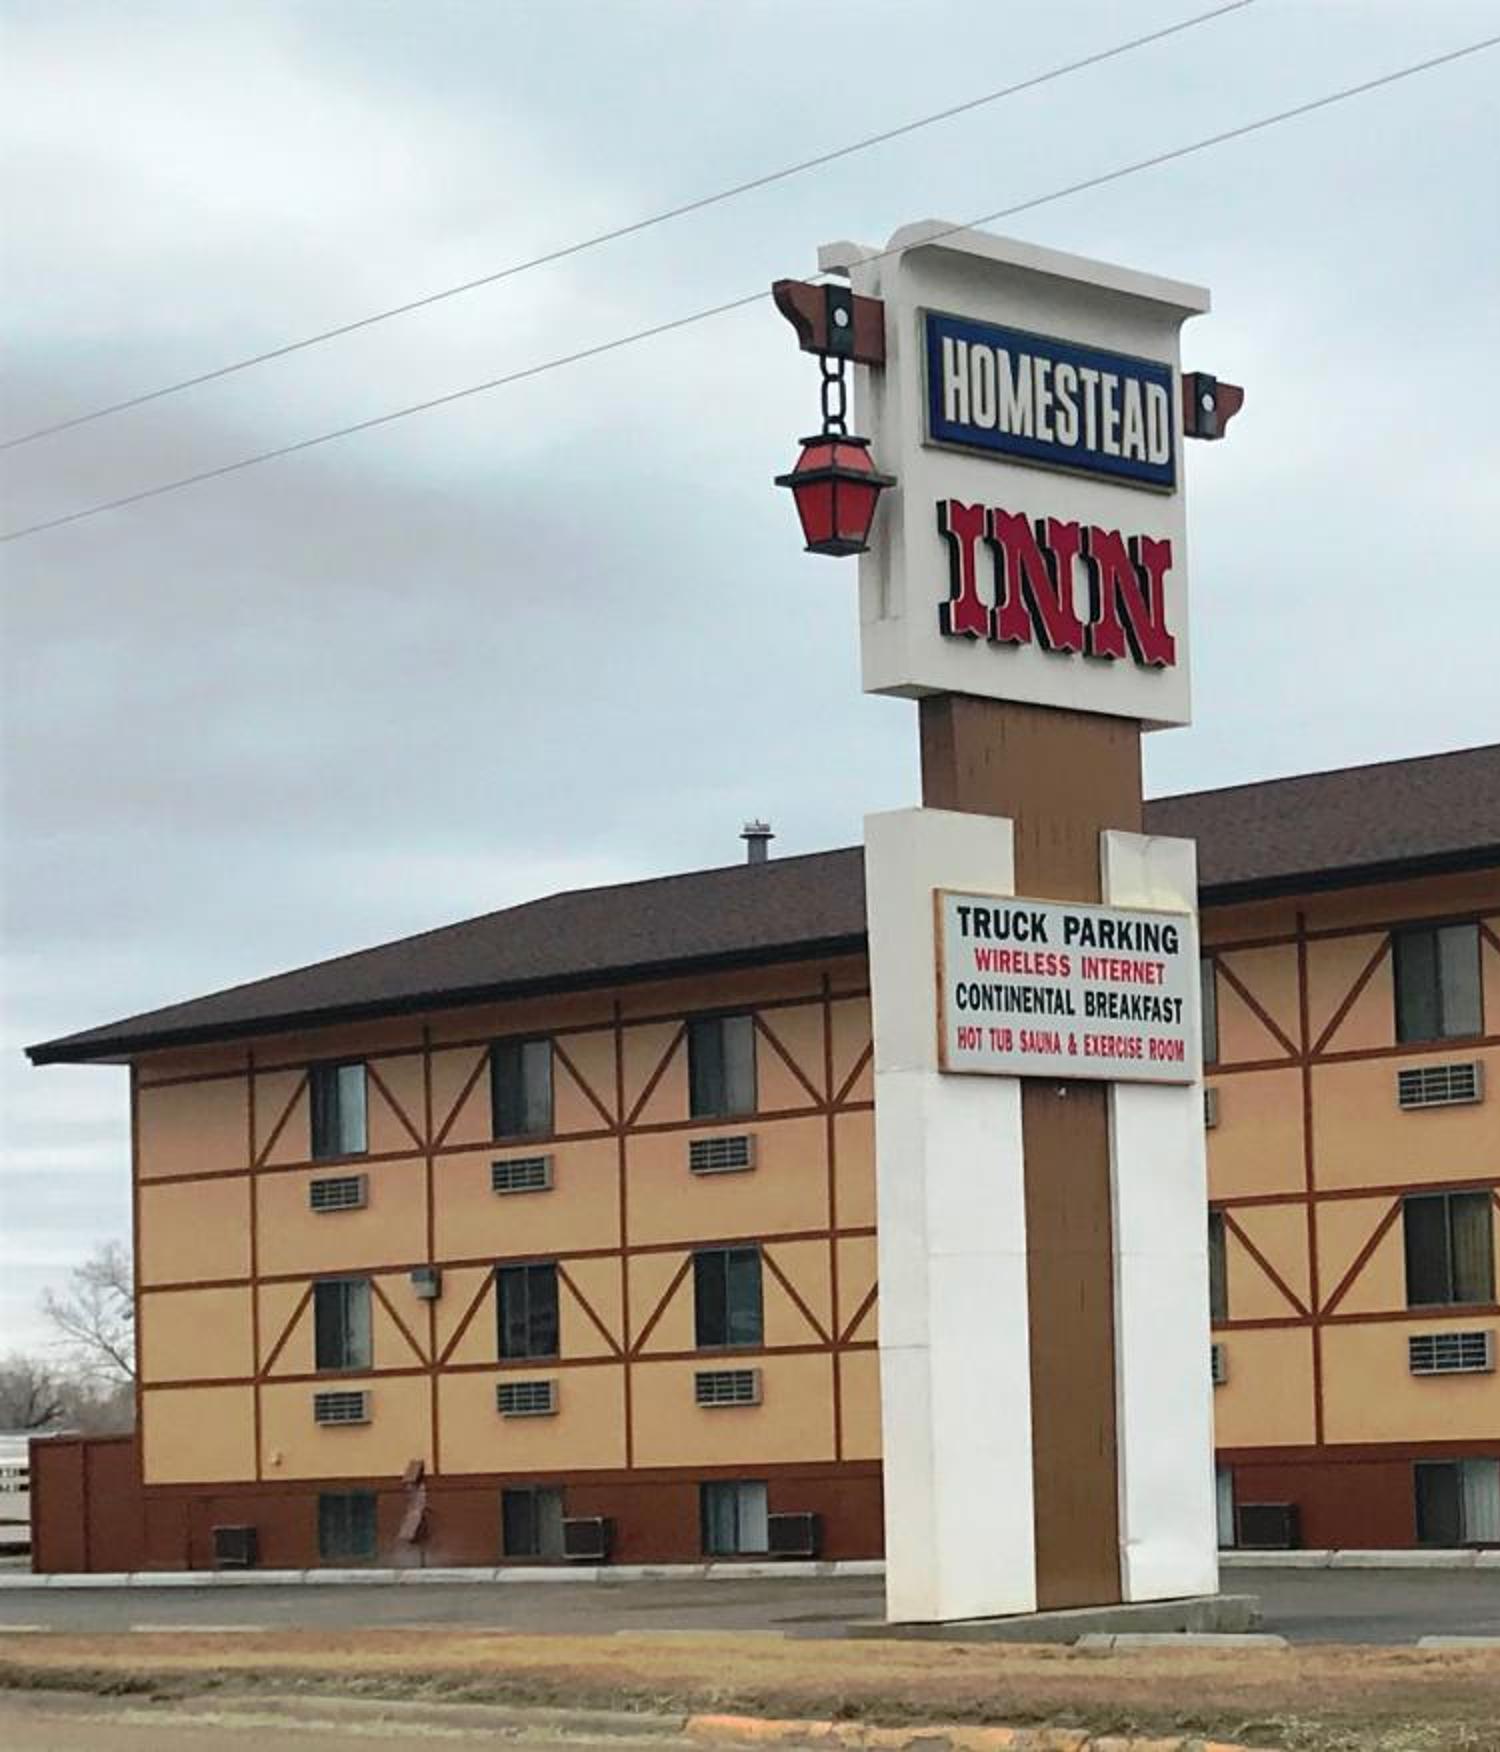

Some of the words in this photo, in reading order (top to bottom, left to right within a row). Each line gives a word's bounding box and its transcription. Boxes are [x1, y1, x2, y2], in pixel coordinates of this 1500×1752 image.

[943, 337, 1170, 465] HOMESTEAD
[937, 499, 1176, 670] INN
[957, 906, 1048, 943] TRUCK
[1063, 916, 1179, 954] PARKING
[975, 949, 1070, 977] WIRELESS
[1082, 957, 1165, 985] INTERNET
[956, 983, 1076, 1016] CONTINENTAL
[1085, 992, 1183, 1025] BREAKFAST
[958, 1027, 983, 1050] HOT
[990, 1029, 1013, 1052] TUB
[1019, 1031, 1062, 1055] SAUNA
[1068, 1034, 1077, 1056] &
[1084, 1035, 1143, 1059] EXERCISE
[1149, 1038, 1185, 1061] ROOM
